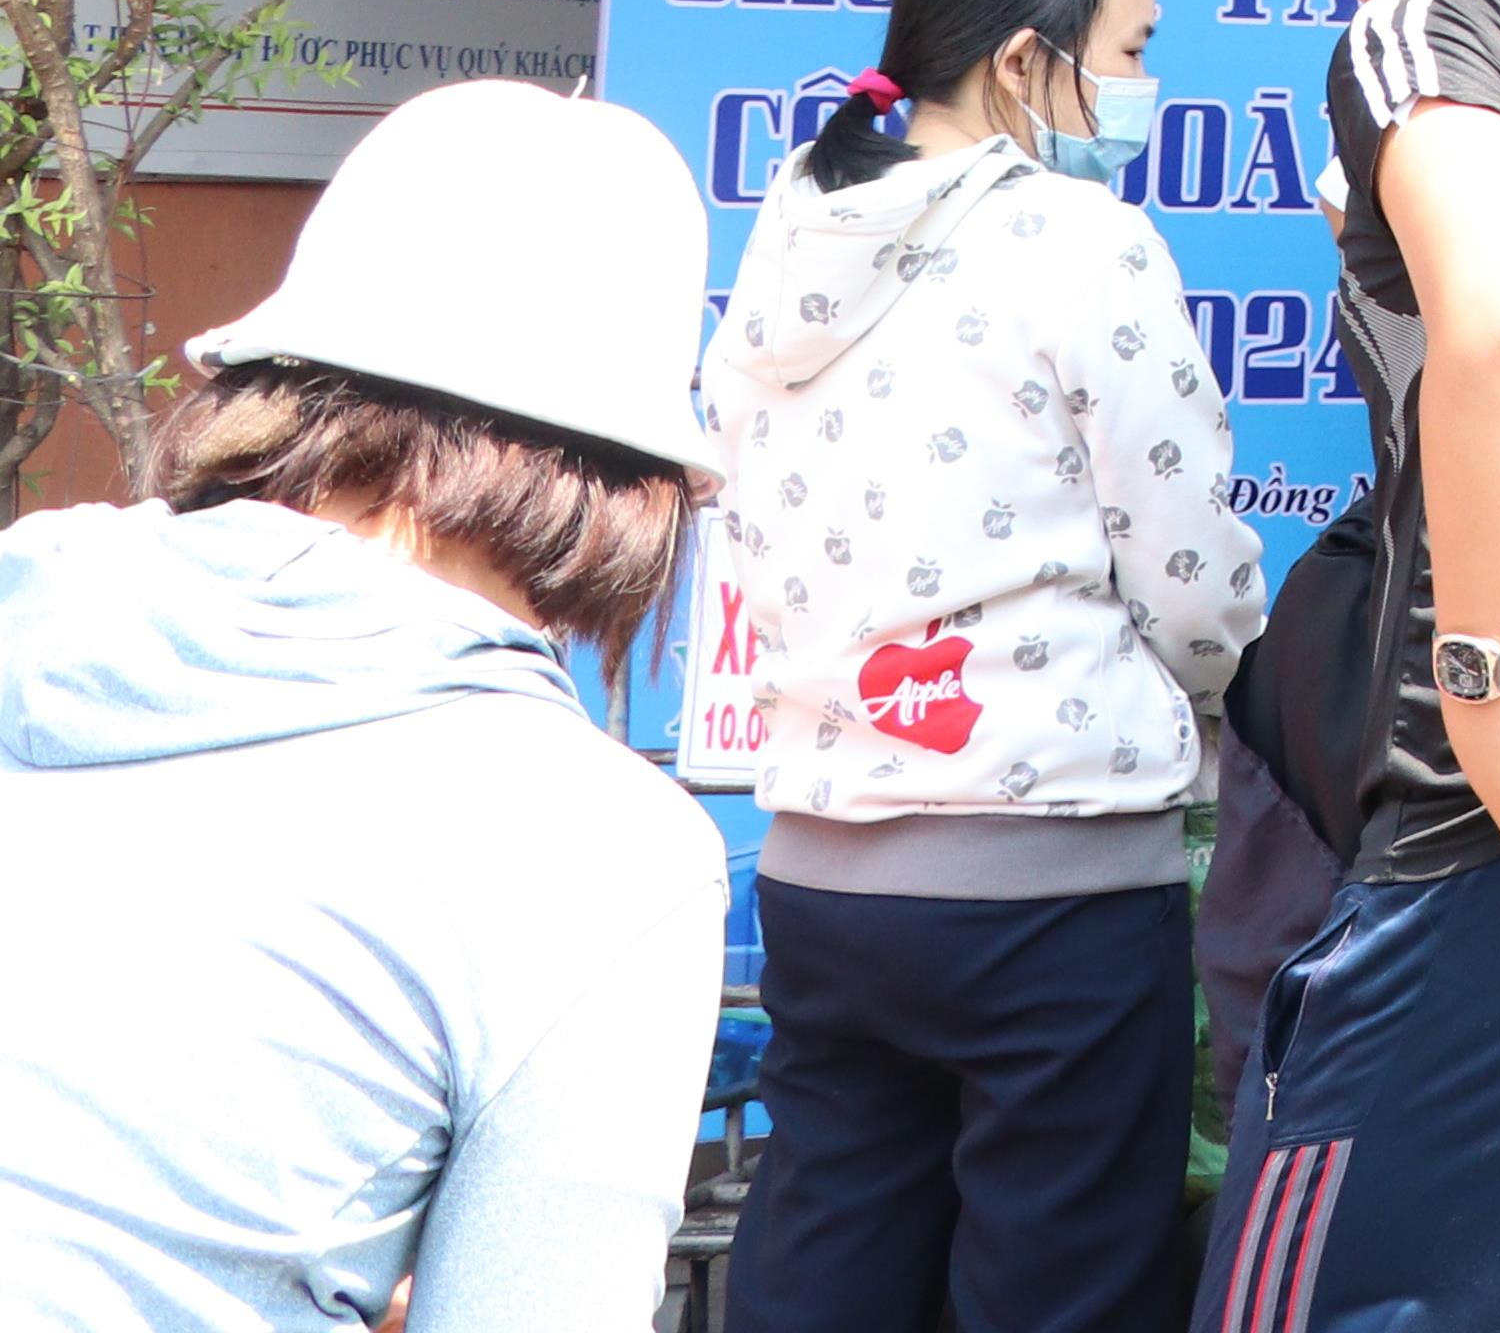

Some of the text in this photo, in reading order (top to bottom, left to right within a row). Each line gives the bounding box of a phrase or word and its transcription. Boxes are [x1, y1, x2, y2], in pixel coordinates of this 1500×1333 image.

[345, 40, 412, 75] PHỤC
[418, 44, 452, 78] VỤ
[456, 40, 509, 79] QUÝ
[514, 44, 595, 80] KHÁCH
[1230, 473, 1342, 519] Đồng
[858, 669, 962, 727] Apple
